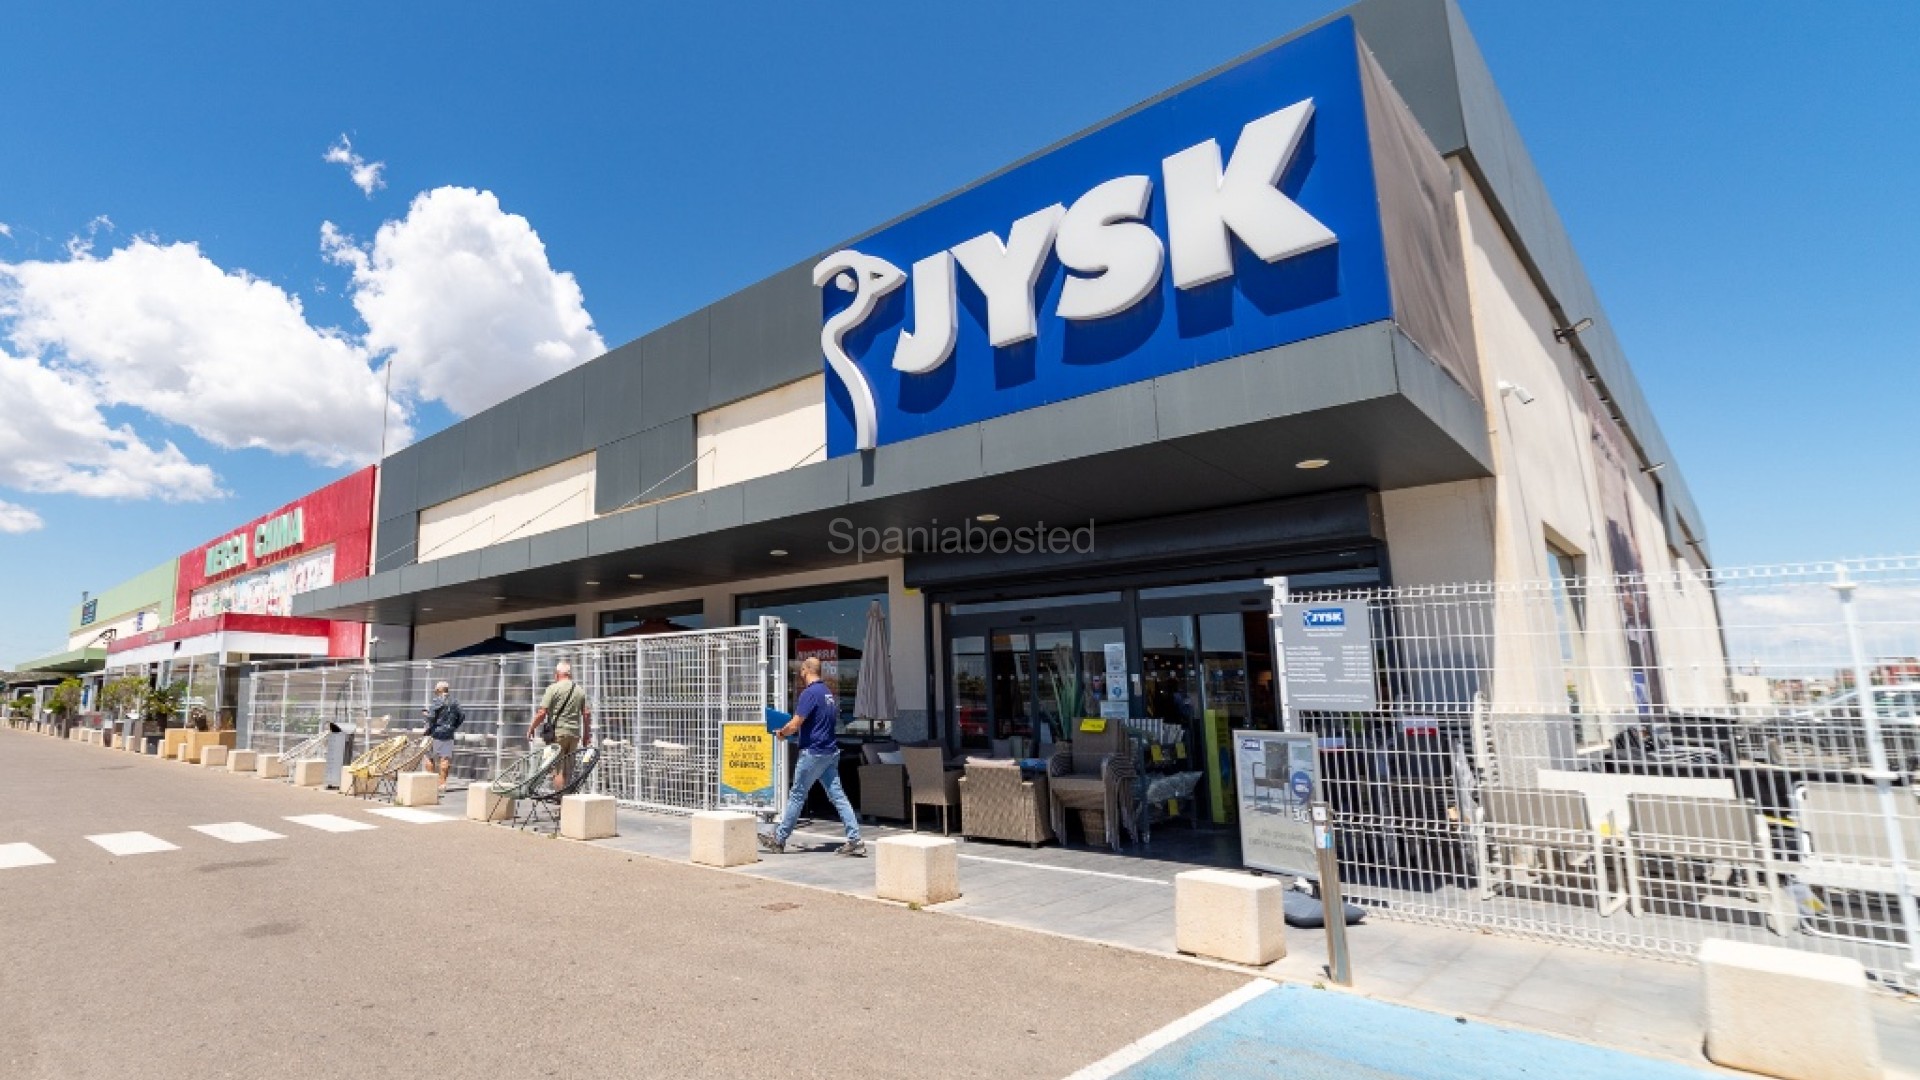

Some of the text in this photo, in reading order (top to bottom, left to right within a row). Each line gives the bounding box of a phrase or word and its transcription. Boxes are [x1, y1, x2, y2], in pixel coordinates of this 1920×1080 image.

[892, 96, 1338, 374] JYSK
[1311, 612, 1342, 622] JYSK
[728, 760, 766, 770] OFERTAS
